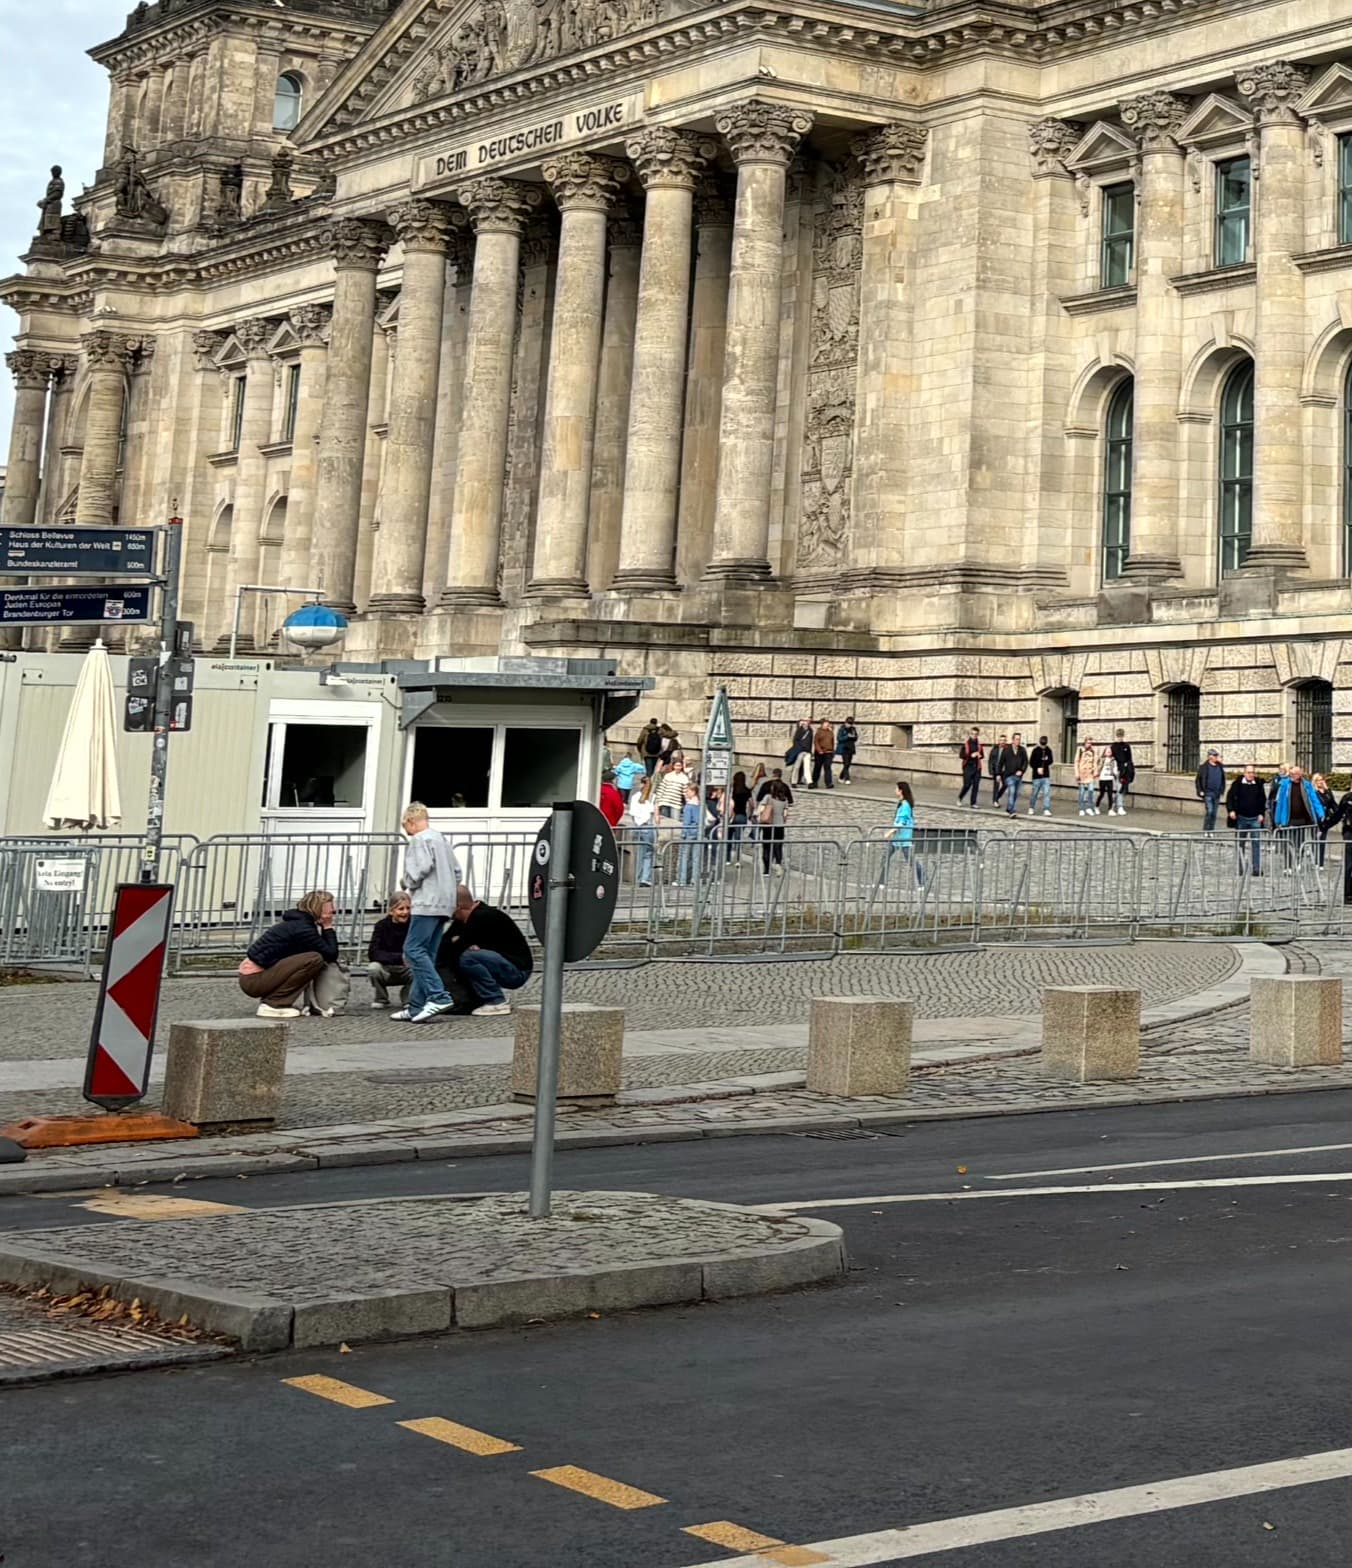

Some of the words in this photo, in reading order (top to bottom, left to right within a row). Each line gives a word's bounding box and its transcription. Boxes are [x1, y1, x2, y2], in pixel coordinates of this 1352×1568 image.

[437, 149, 467, 176] DEM
[478, 120, 564, 164] DEUTSCHEN
[575, 103, 624, 133] VOLKE
[93, 542, 111, 550] Welt
[4, 593, 39, 601] Denkmal
[4, 601, 28, 609] Juden
[29, 601, 61, 609] Europas
[3, 610, 60, 619] Brandenburger
[62, 609, 74, 617] Tor
